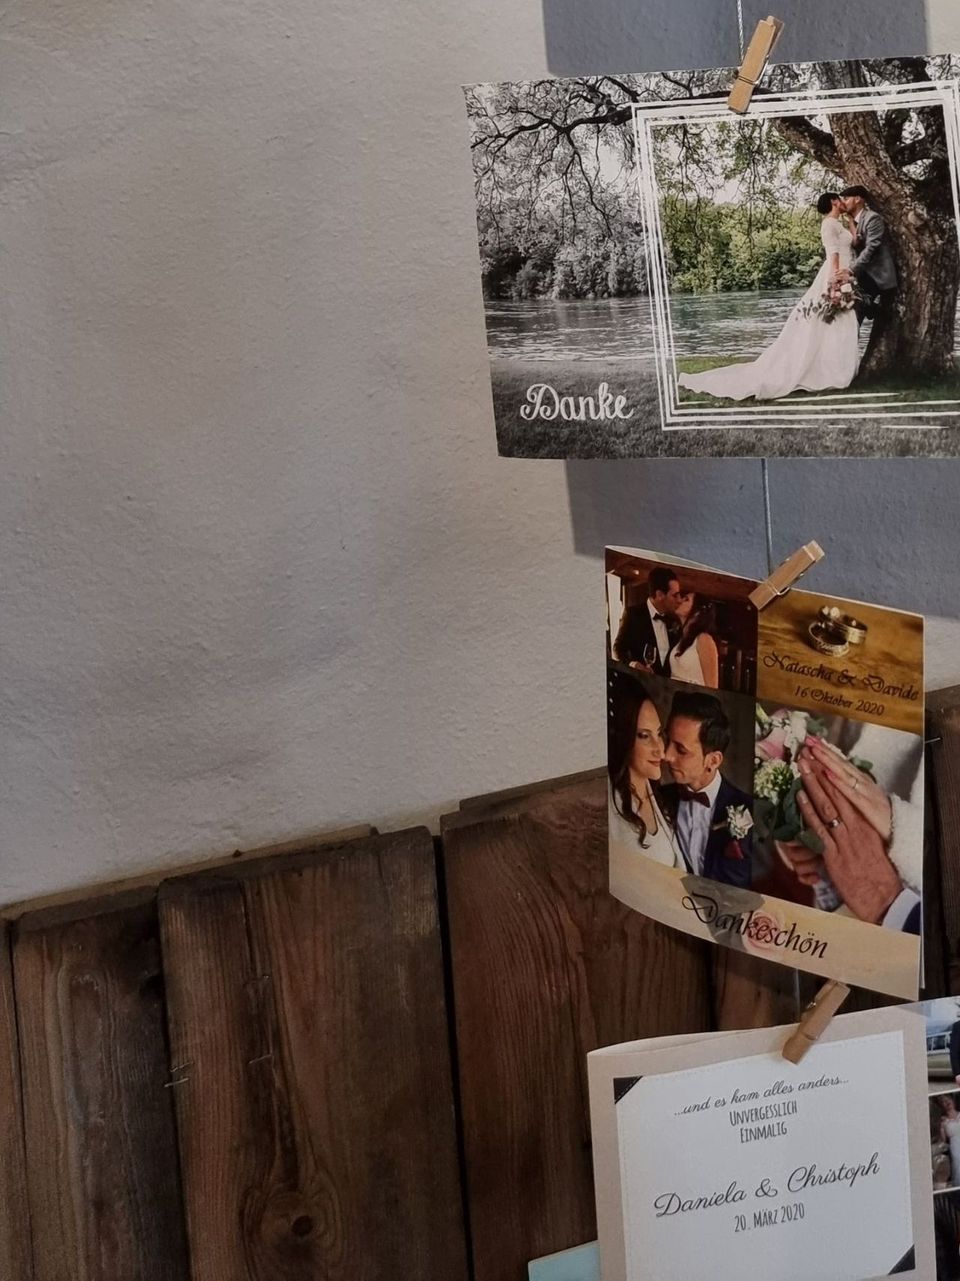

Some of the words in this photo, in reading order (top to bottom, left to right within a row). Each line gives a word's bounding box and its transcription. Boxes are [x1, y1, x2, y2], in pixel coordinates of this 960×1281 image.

[520, 382, 634, 421] Danke
[763, 650, 832, 681] Natascha
[837, 669, 857, 687] &
[863, 674, 919, 702] Davide
[794, 685, 808, 698] 16
[810, 688, 853, 710] Oktober
[855, 699, 885, 717] 2020
[681, 891, 829, 959] Dankeschön
[714, 1098, 727, 1109] es
[763, 1080, 794, 1099] alles
[653, 1180, 748, 1218] Daniela
[754, 1178, 779, 1198] &
[787, 1151, 881, 1193] Christoph
[780, 1202, 805, 1223] 2020
